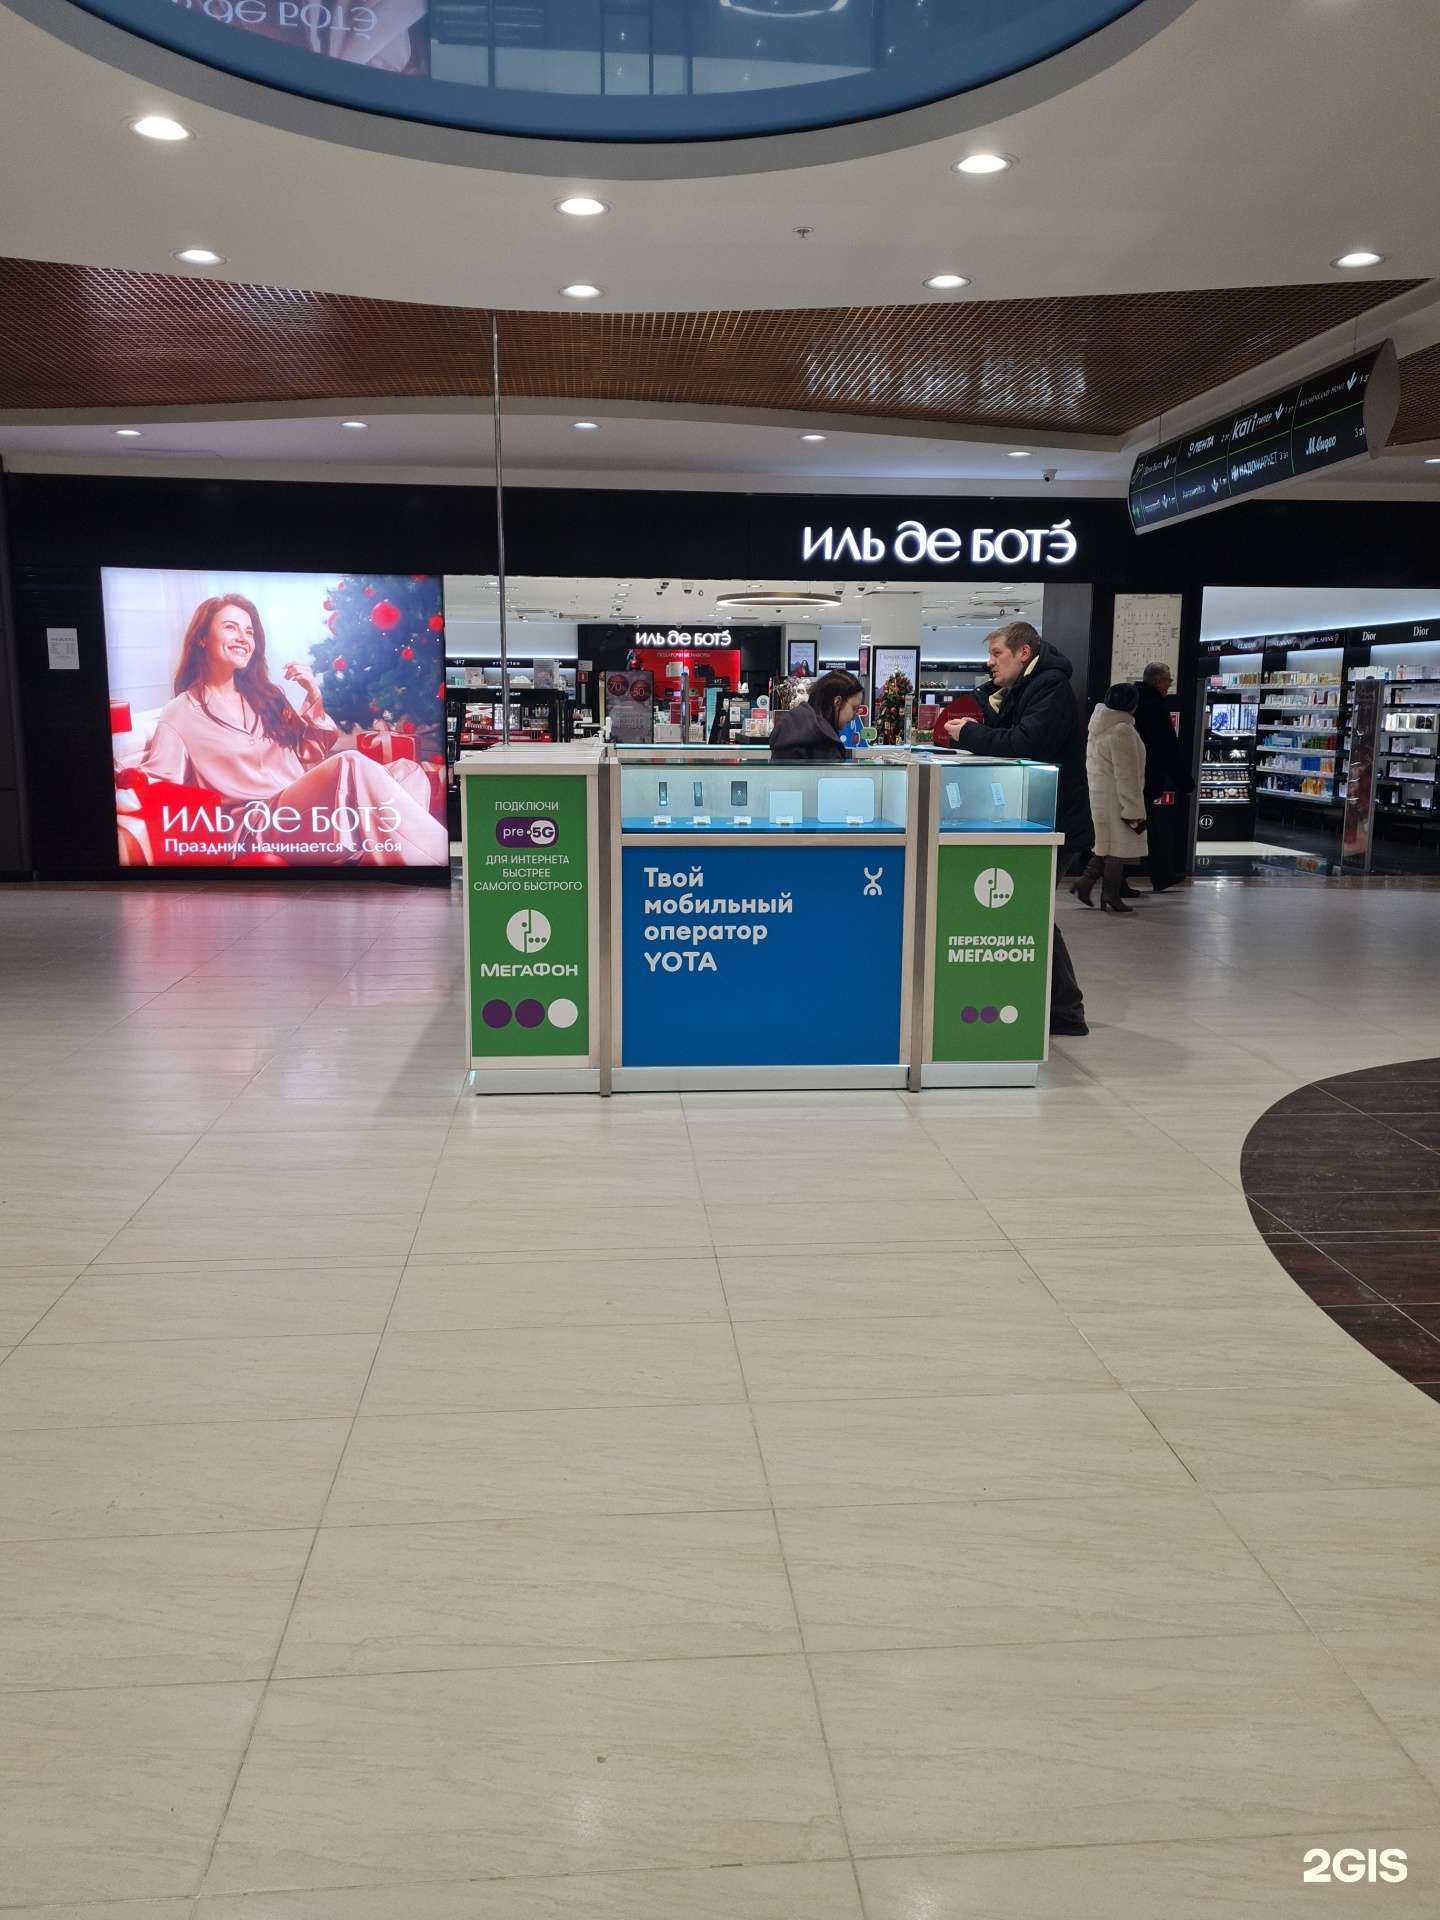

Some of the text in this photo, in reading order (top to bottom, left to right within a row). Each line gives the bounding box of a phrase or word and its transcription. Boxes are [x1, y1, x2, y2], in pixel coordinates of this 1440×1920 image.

[803, 526, 886, 562] ИЛЬ
[635, 631, 665, 646] ИЛЬ
[1362, 631, 1377, 641] Dior
[1413, 626, 1430, 637] Dior
[495, 801, 559, 812] ПОДКЛЮЧИ
[162, 805, 235, 833] ИЛЬ
[164, 838, 247, 855] Праздник
[251, 839, 344, 853] начинается
[362, 837, 402, 853] Себя
[486, 854, 570, 865] ДЛЯ ИНТЕРНЕТА
[502, 868, 551, 878] БЫСТРЕЕ
[643, 865, 704, 888] Твой
[473, 881, 583, 891] САМОГО БЫСТРОГО
[644, 892, 793, 914] мобильный
[644, 924, 768, 945] оператор
[948, 935, 1035, 947] ПЕРЕХОДИ НА
[644, 951, 718, 972] YOTA
[948, 948, 1036, 963] МЕГАФОН
